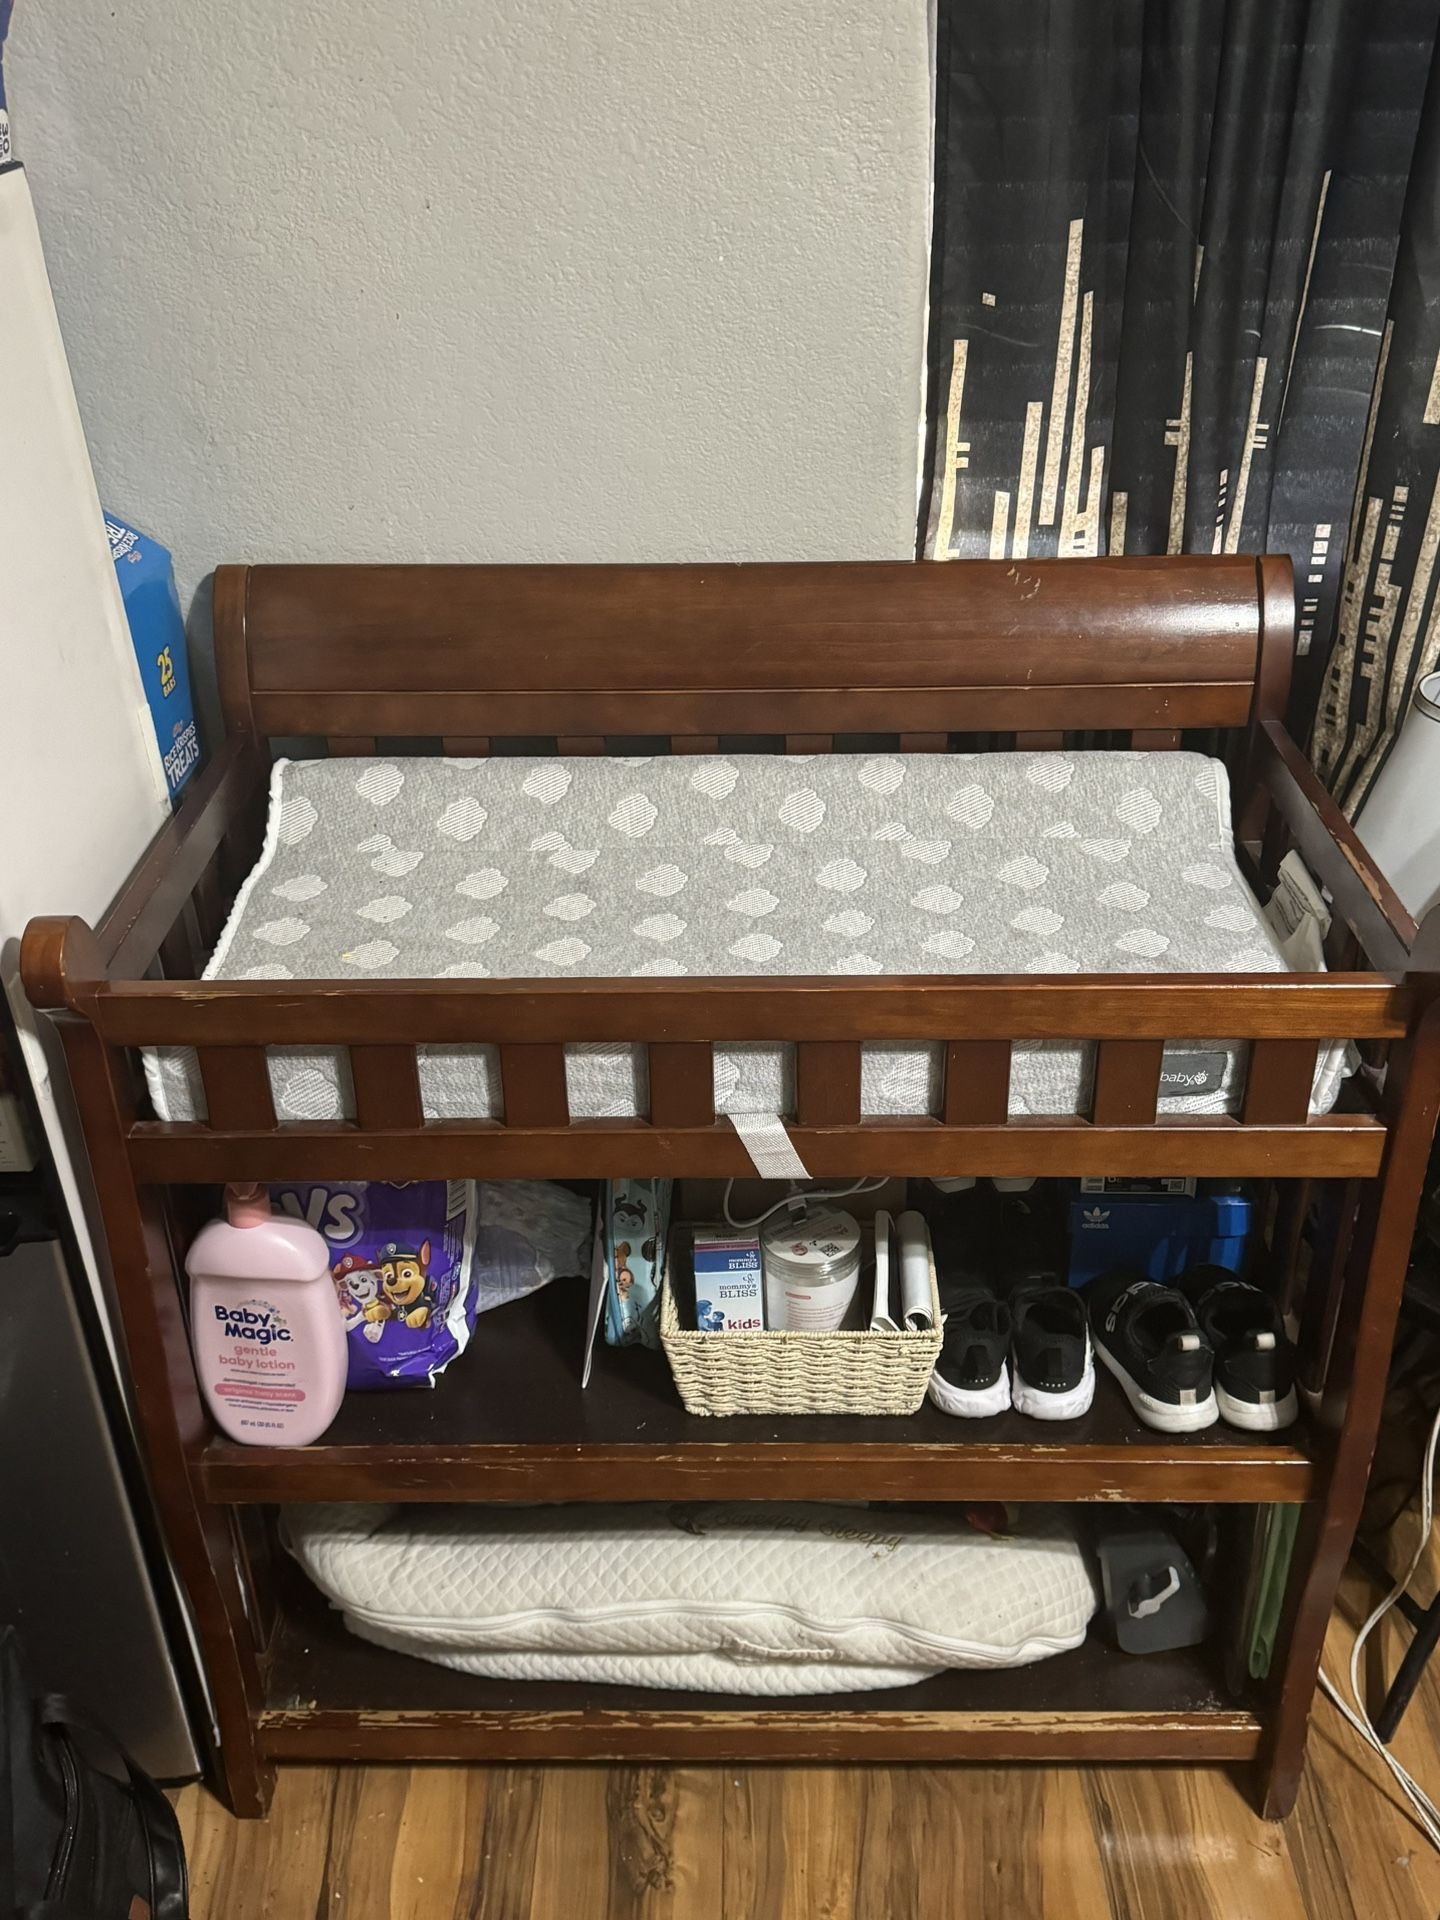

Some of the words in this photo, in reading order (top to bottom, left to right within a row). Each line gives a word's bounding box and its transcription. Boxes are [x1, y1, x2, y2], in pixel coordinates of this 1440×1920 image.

[157, 646, 173, 686] 25
[164, 745, 177, 771] RICE
[168, 740, 199, 788] TREATS
[1160, 1072, 1194, 1086] baby
[729, 1261, 758, 1270] BLISS
[720, 1289, 758, 1299] BLISS
[214, 1305, 271, 1328] Baby
[728, 1319, 761, 1330] kids
[225, 1322, 291, 1345] Magic
[234, 1345, 278, 1357] gentle
[219, 1354, 254, 1369] baby
[256, 1360, 296, 1371] lotion
